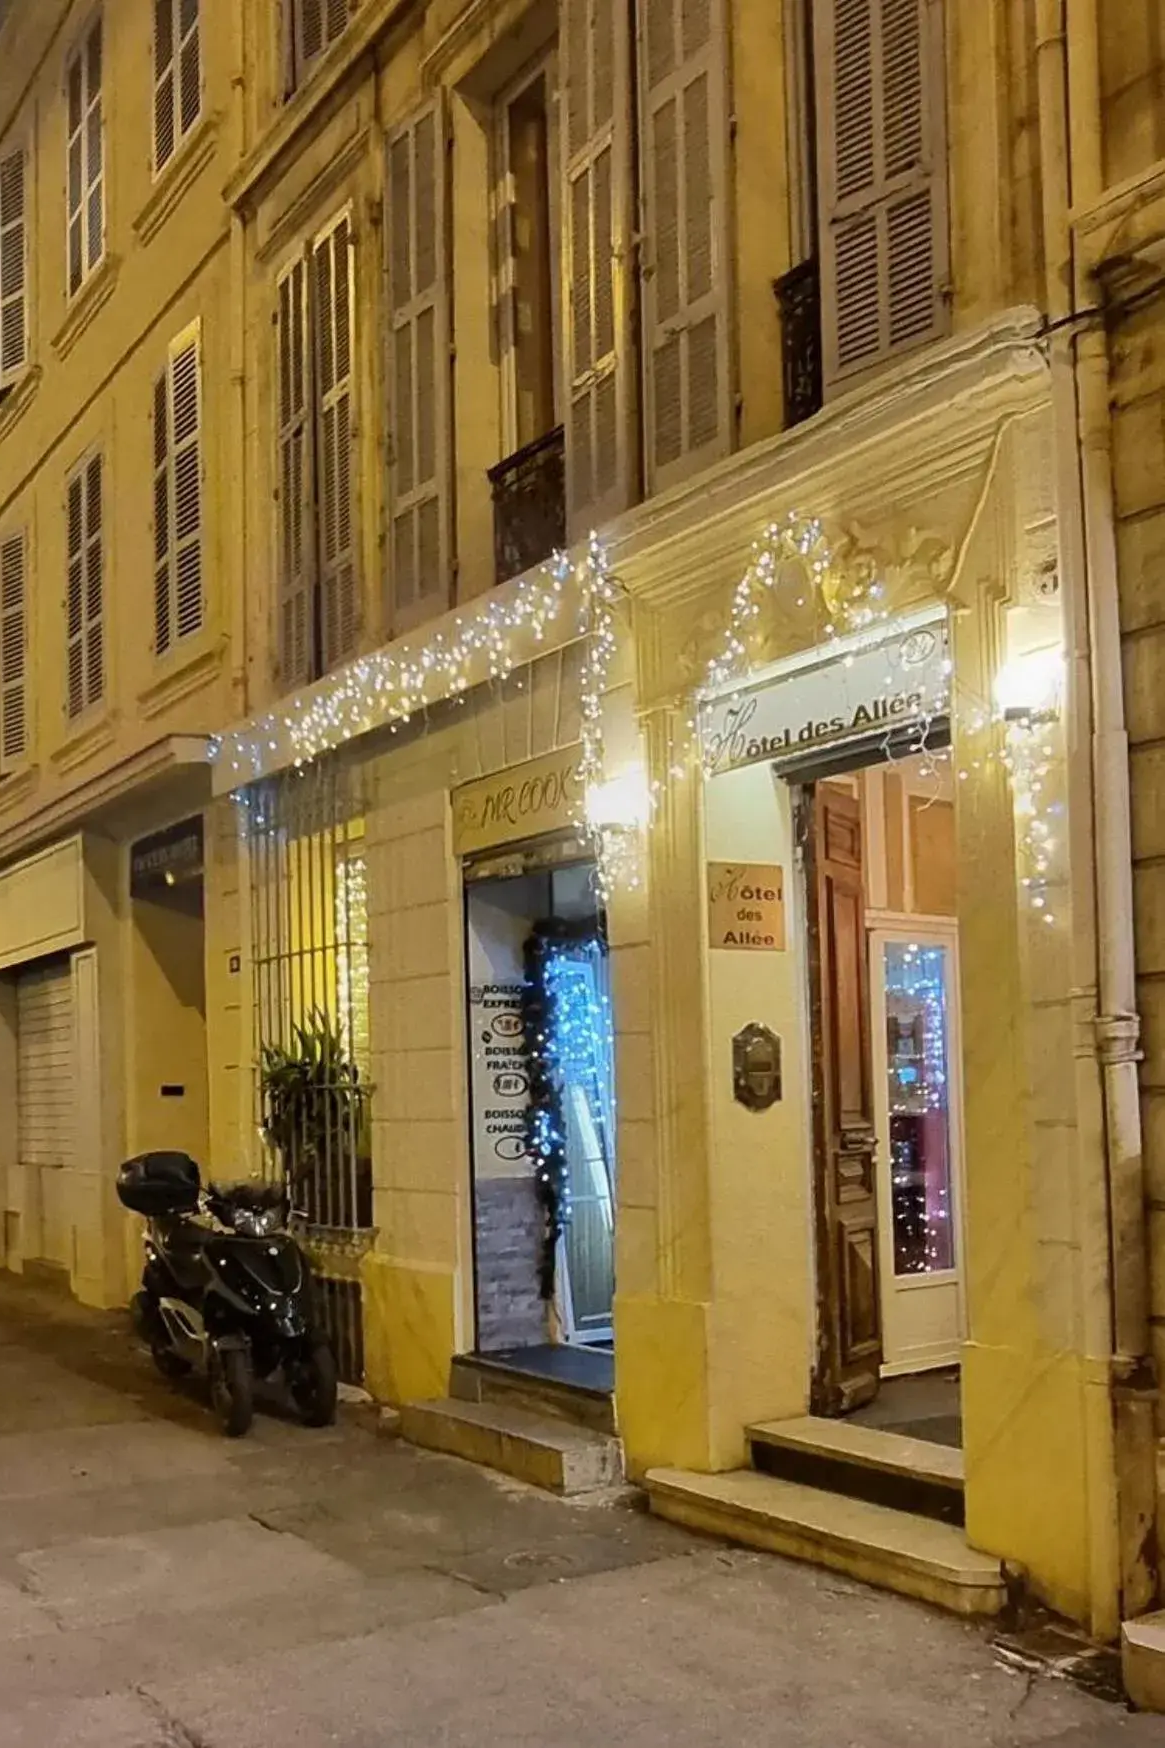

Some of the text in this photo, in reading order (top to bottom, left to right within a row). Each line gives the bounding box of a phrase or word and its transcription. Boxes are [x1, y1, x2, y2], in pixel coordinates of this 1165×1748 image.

[706, 692, 922, 770] Hôtel des Allée
[710, 867, 783, 904] Hôtel
[736, 907, 764, 922] des
[723, 930, 775, 946] Allée
[483, 985, 523, 994] BOISSO
[485, 1110, 524, 1120] BOISSO
